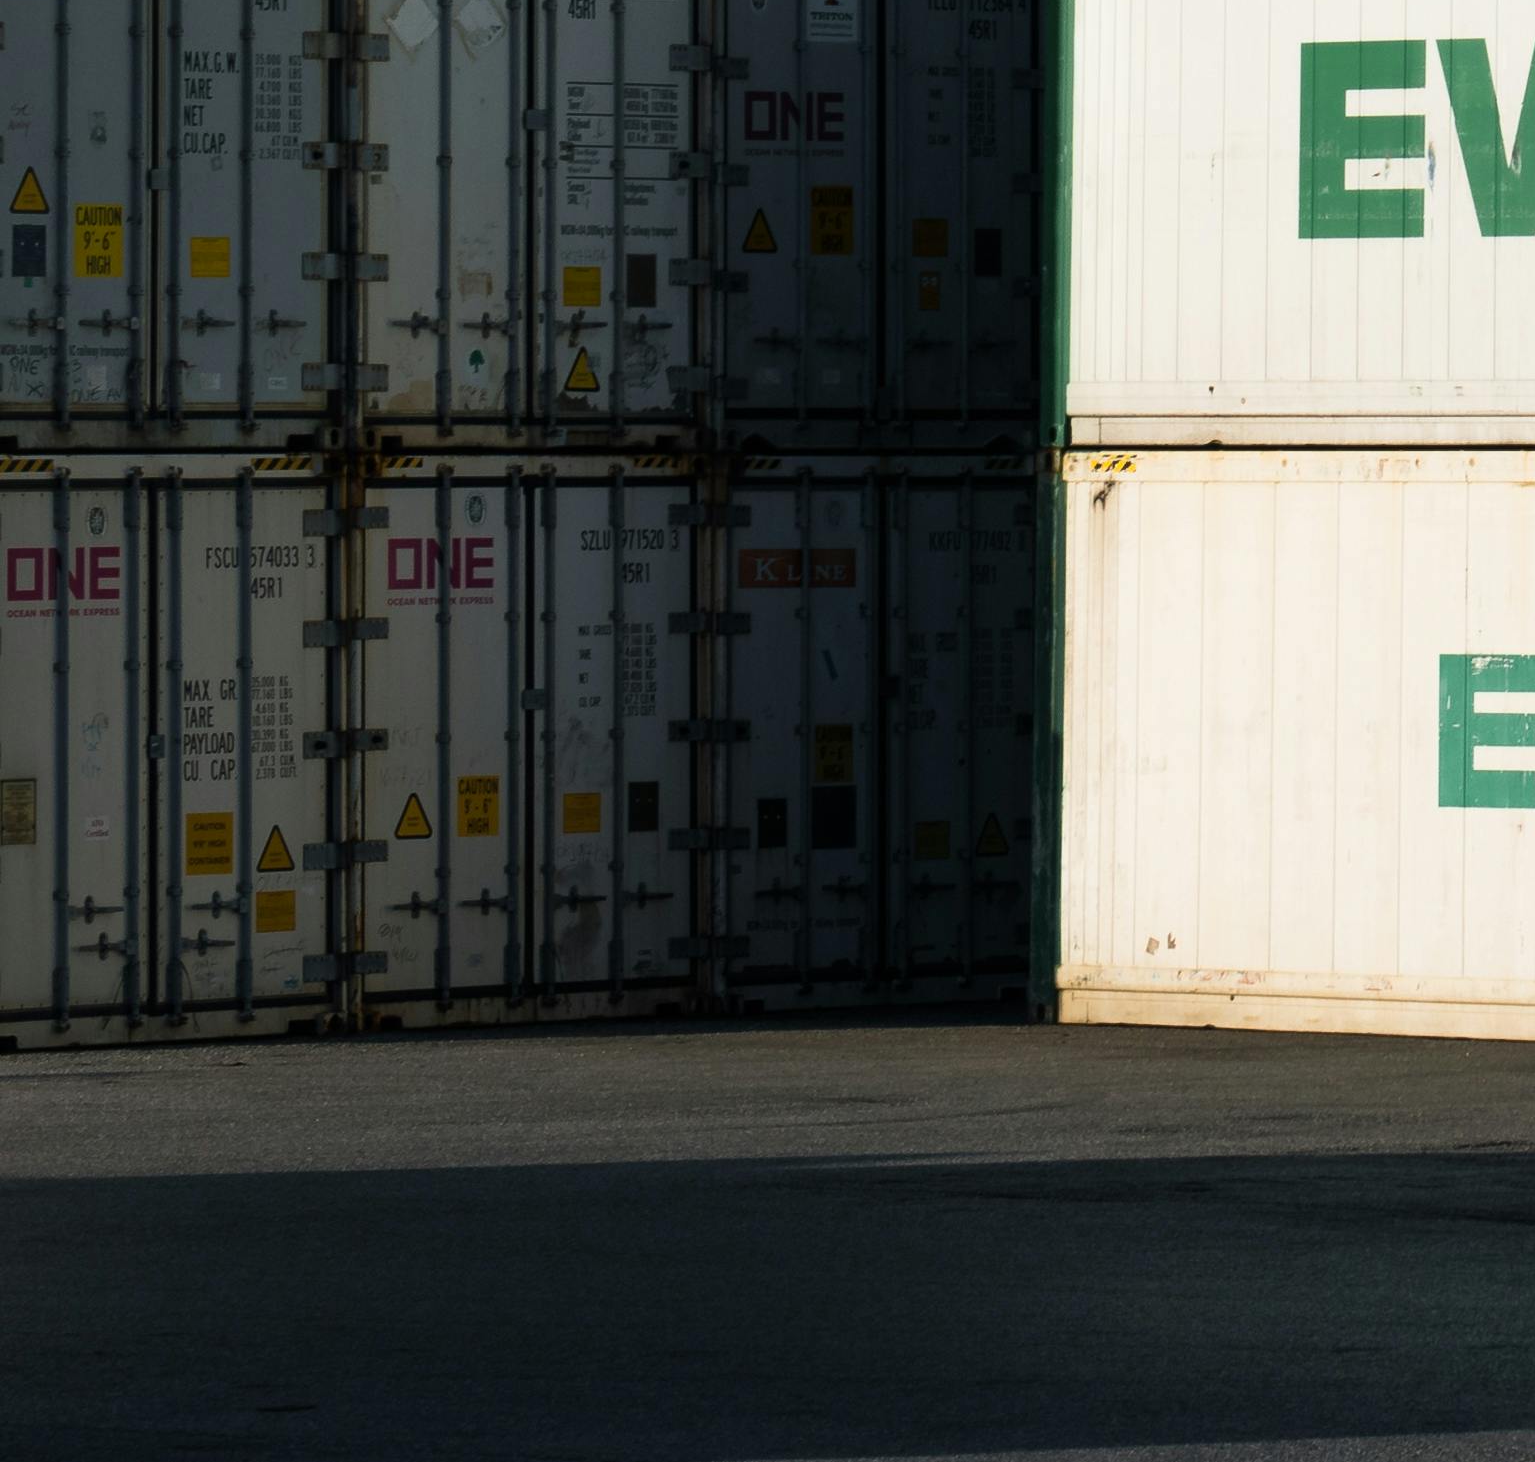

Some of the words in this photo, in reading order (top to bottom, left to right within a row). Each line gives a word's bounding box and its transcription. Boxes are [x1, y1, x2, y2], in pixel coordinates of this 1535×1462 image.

[568, 0, 596, 19] 45R1
[745, 91, 844, 141] ONE
[76, 206, 121, 226] CAUTION
[86, 256, 111, 274] HIGH
[206, 547, 239, 569] FSCU
[308, 546, 315, 567] 3
[388, 538, 493, 589] ONE
[7, 547, 120, 601] ONE
[251, 578, 282, 599] 45R1
